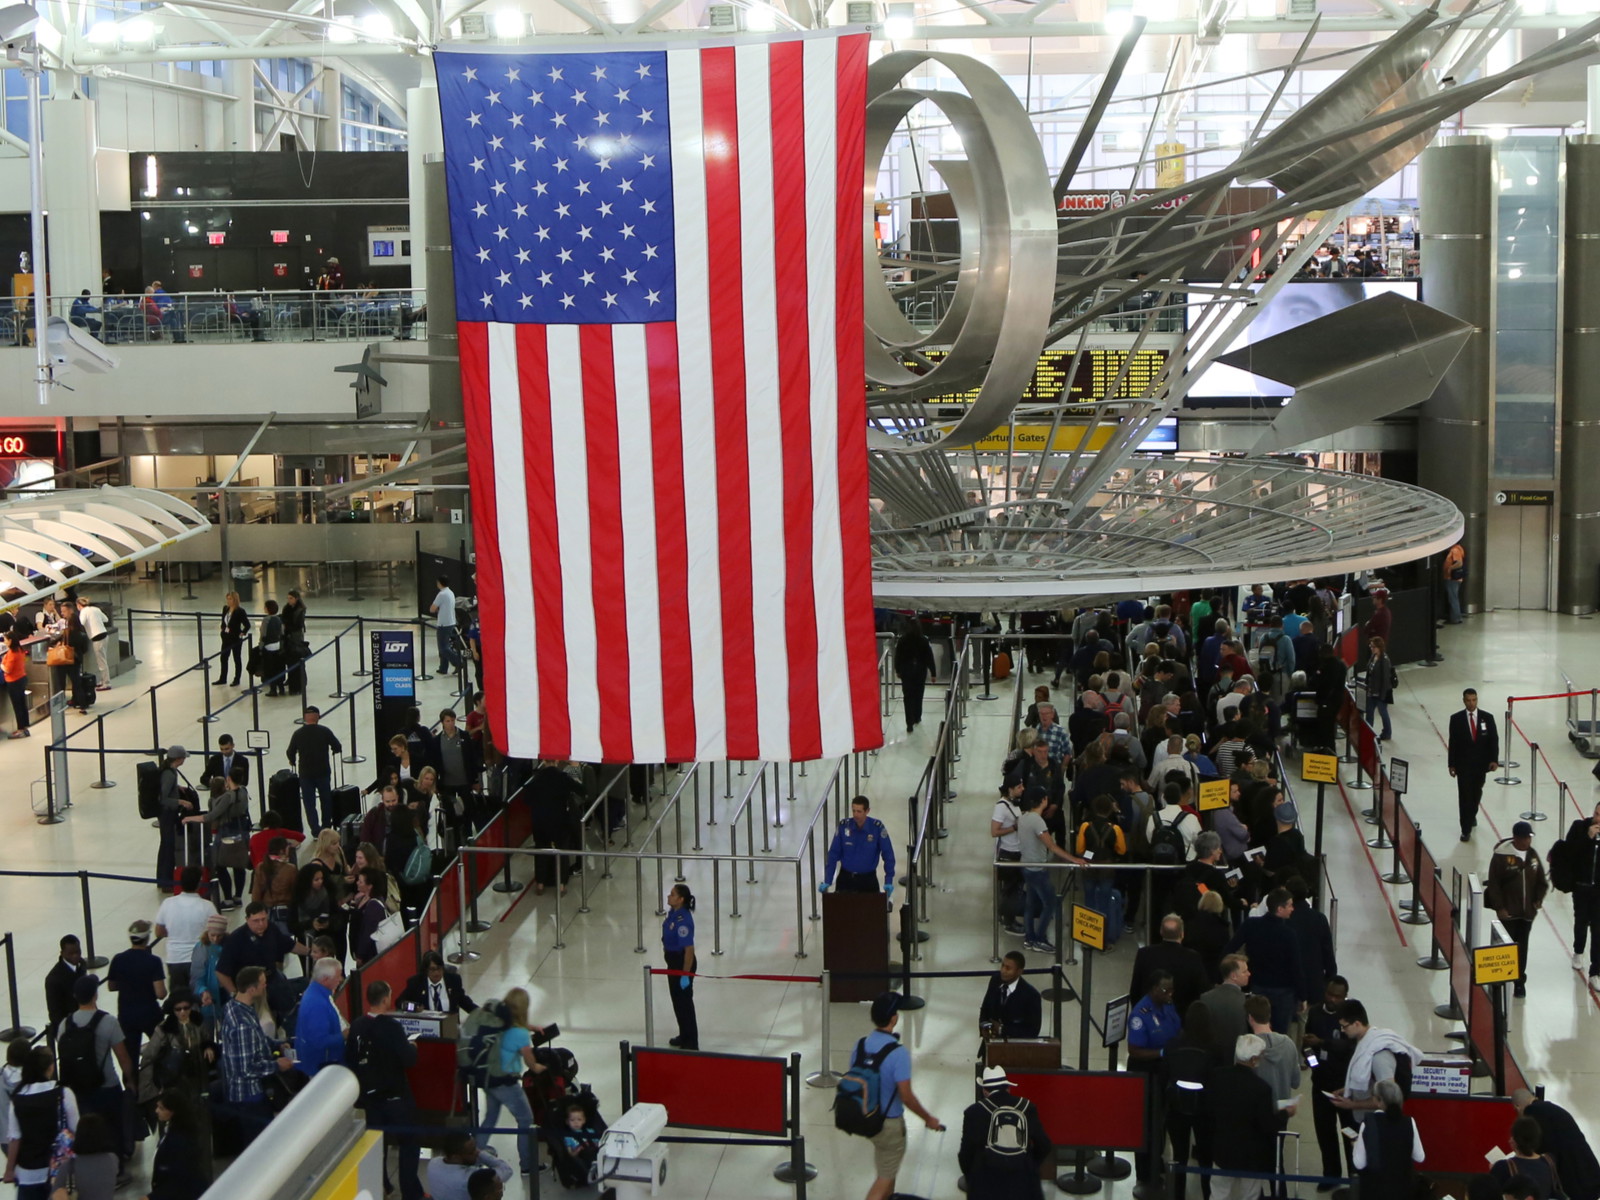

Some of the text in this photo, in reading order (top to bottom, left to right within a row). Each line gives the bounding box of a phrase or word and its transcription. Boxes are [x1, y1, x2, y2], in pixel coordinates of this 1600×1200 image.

[1018, 433, 1046, 443] Gates
[385, 643, 408, 652] LOT
[372, 643, 382, 710] STAR ALLIANCE
[1423, 1067, 1447, 1075] SECURITY
